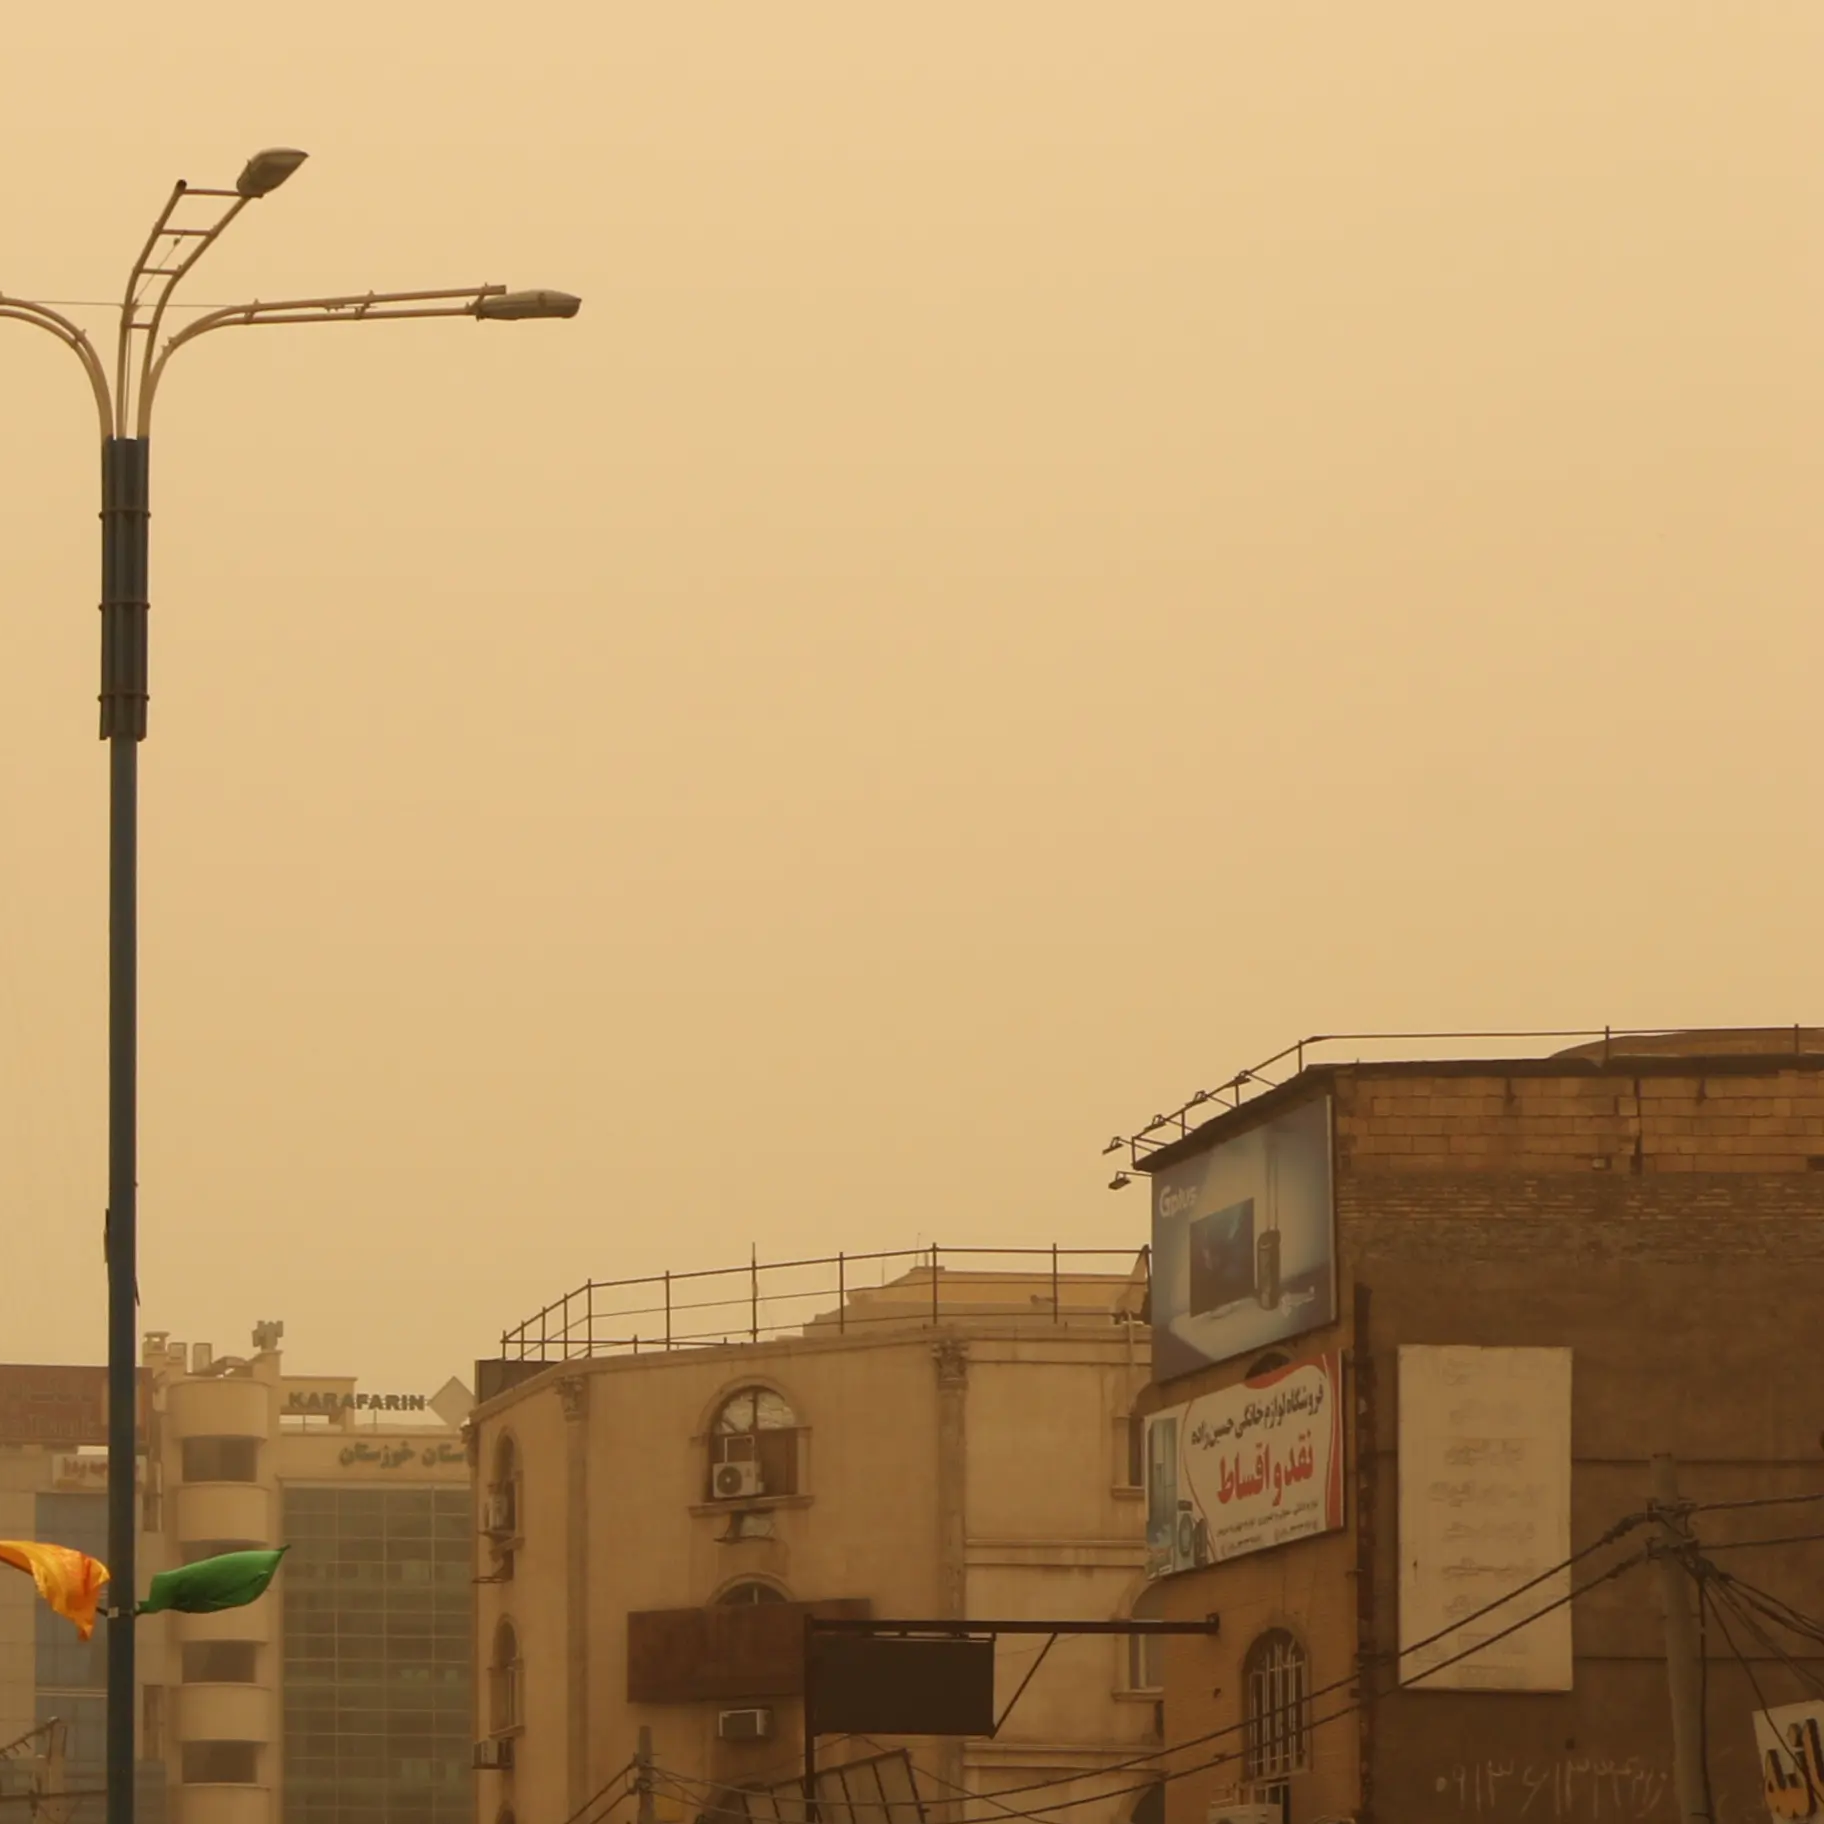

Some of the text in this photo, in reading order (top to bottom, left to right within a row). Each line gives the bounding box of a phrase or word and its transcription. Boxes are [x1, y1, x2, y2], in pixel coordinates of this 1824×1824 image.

[288, 1391, 425, 1411] KARAFARIN
[1217, 1442, 1271, 1504] اقساط
[1284, 1428, 1314, 1487] نقد
